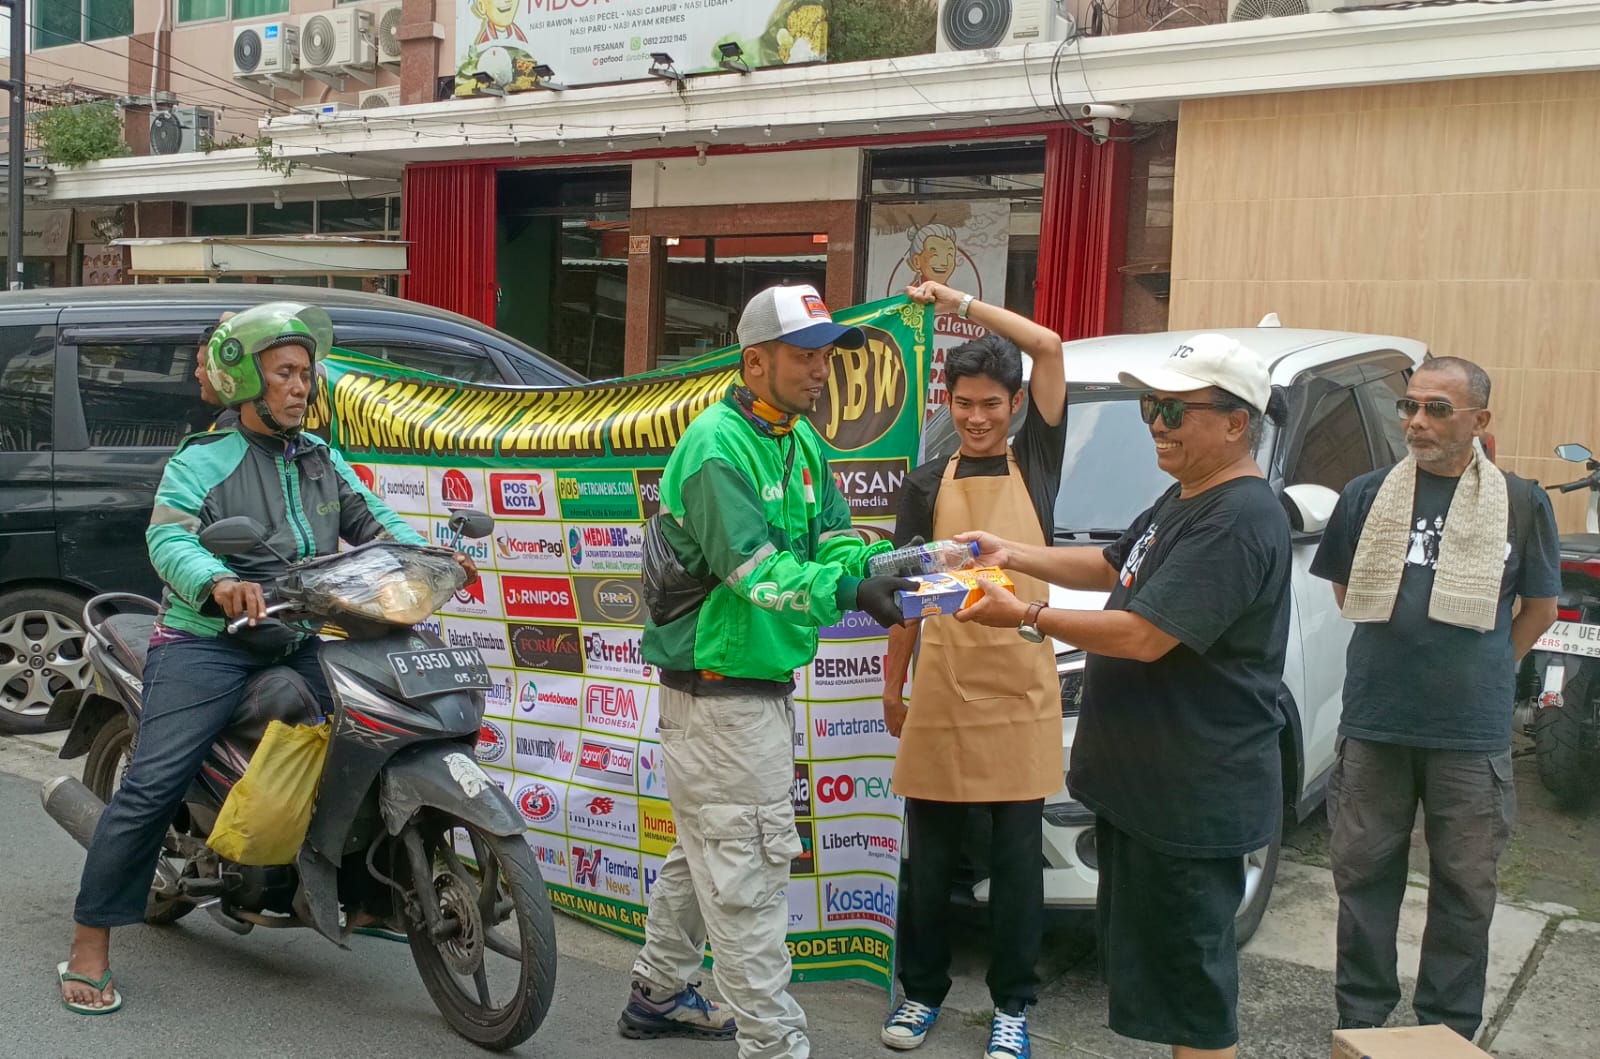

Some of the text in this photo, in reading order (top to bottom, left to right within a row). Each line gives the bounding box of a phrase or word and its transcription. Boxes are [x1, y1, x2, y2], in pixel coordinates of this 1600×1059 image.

[530, 22, 545, 31] NASI
[546, 18, 573, 28] RAWON
[579, 14, 596, 23] NASI
[597, 12, 619, 21] PECEL
[626, 8, 643, 17] NASI
[645, 3, 677, 15] CAMPUR
[684, 1, 701, 10] NASI
[569, 14, 686, 36] NASI PARU NASI AYAM KREMES
[569, 45, 592, 55] TERIMA
[593, 41, 625, 53] PESANAN
[334, 373, 456, 450] PROGRAM
[501, 384, 638, 450] BERKAH
[387, 481, 425, 499] suarakarya.id
[444, 476, 469, 501] RN
[503, 483, 528, 494] POS
[504, 495, 537, 508] KOTA
[509, 537, 565, 558] KoranPagi
[448, 629, 473, 649] Jakarta
[472, 632, 506, 651] Shimbun
[394, 649, 484, 674] B 3950 BMX
[815, 655, 882, 678] BERNAS
[586, 684, 638, 722] FEM
[588, 715, 636, 730] INDONESIA
[568, 811, 637, 834] imparsial
[605, 877, 631, 897] News
[620, 907, 631, 924] &
